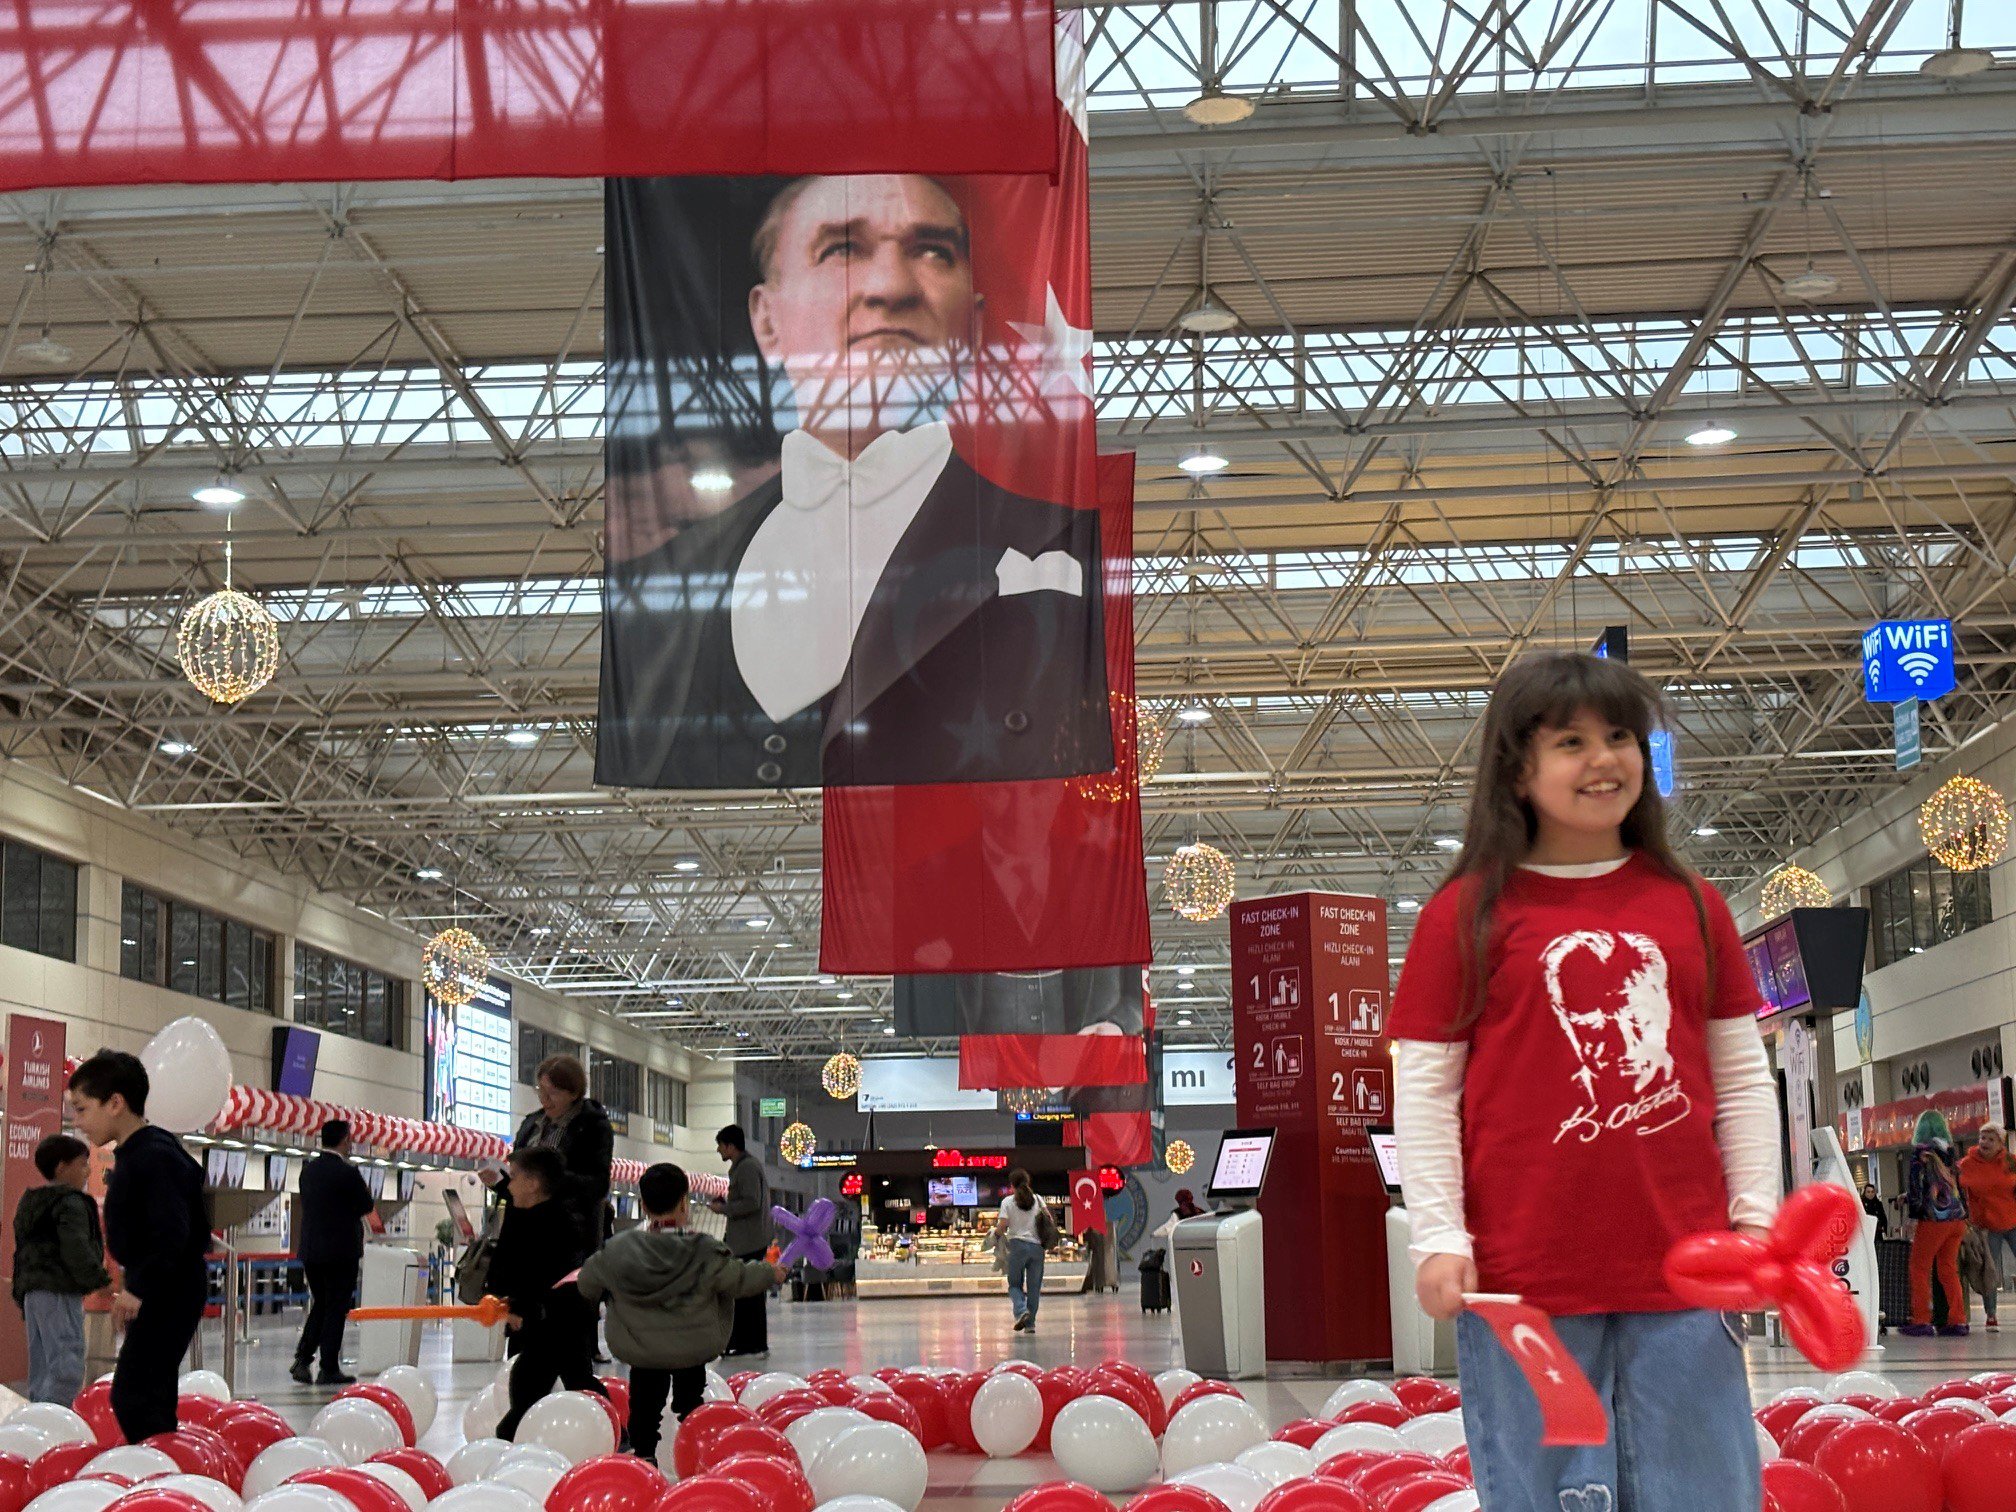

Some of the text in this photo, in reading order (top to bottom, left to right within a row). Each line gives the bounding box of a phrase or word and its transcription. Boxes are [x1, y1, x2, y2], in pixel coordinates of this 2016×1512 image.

[1863, 627, 1882, 660] WiFi
[1885, 624, 1948, 650] WiFi
[1241, 906, 1299, 925] FAST CHECK-IN
[1320, 906, 1376, 922] FAST CHECK-IN
[1260, 924, 1281, 938] ZONE
[1340, 922, 1360, 935] ZONE
[1341, 943, 1374, 955] CHECK-IN
[1340, 955, 1360, 966] ALANI
[1250, 974, 1260, 1001] 1
[1328, 992, 1339, 1021] 1
[1253, 1042, 1264, 1068] 2
[23, 1060, 50, 1075] TURKISH
[22, 1074, 50, 1090] AIRLINES
[1331, 1071, 1344, 1101] 2
[9, 1123, 41, 1140] ECONOMY
[8, 1142, 30, 1160] CLASS
